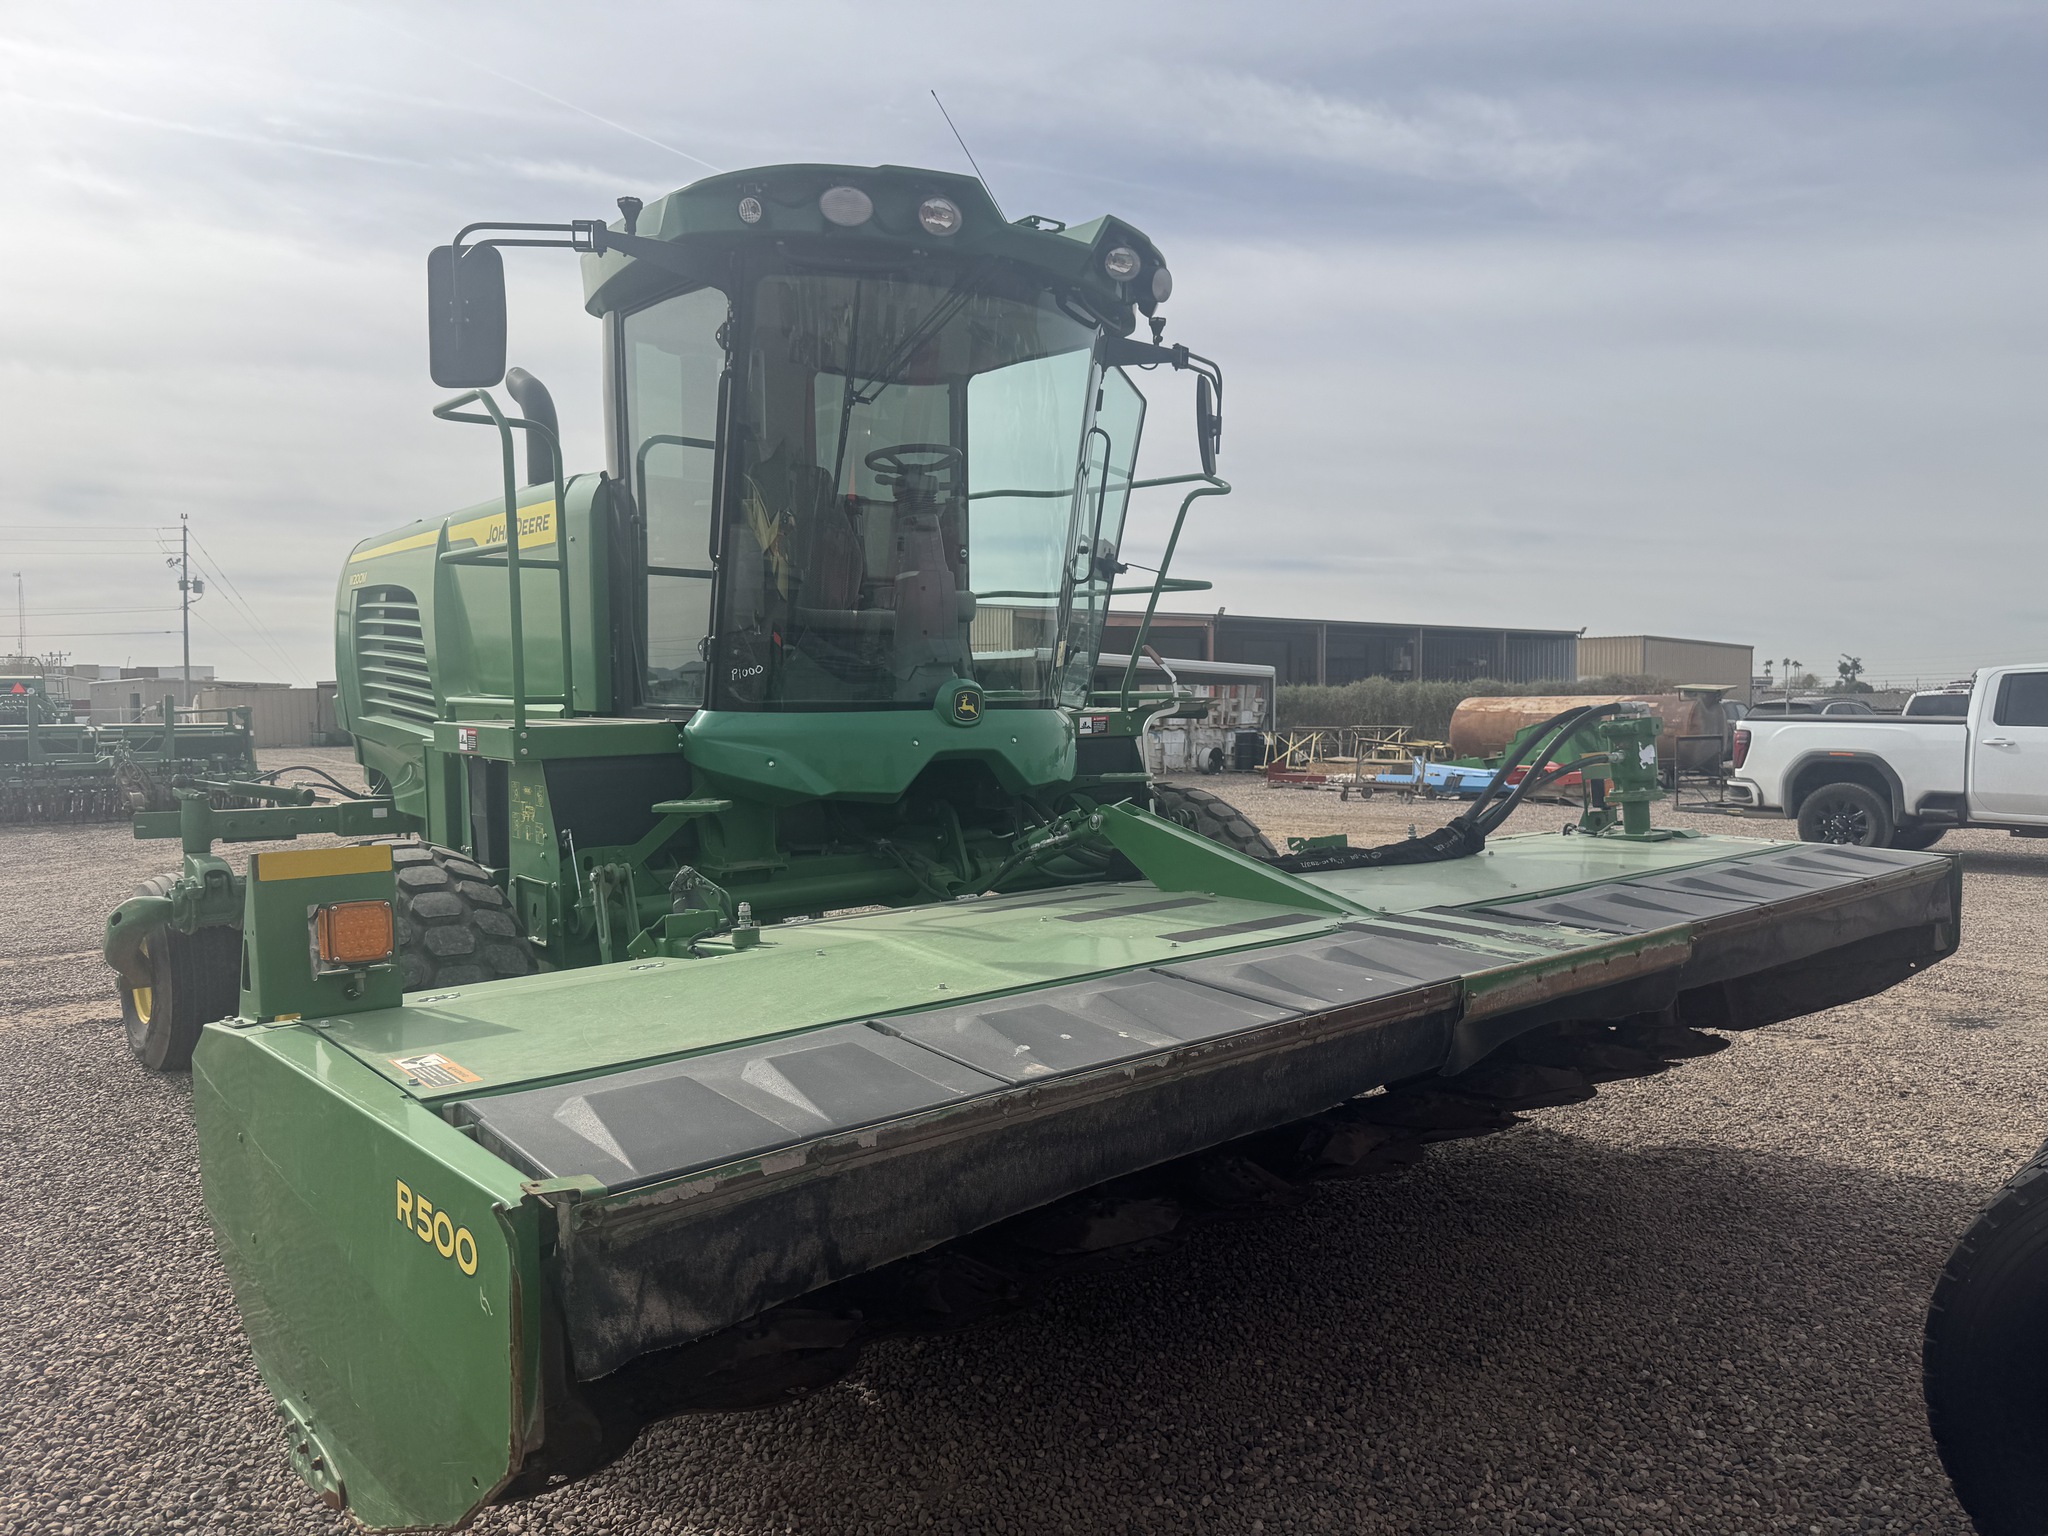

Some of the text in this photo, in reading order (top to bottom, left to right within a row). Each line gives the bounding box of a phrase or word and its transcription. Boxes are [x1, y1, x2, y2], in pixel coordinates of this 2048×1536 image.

[486, 523, 507, 545] JOH
[731, 664, 764, 681] P1000
[396, 1178, 478, 1277] R500
